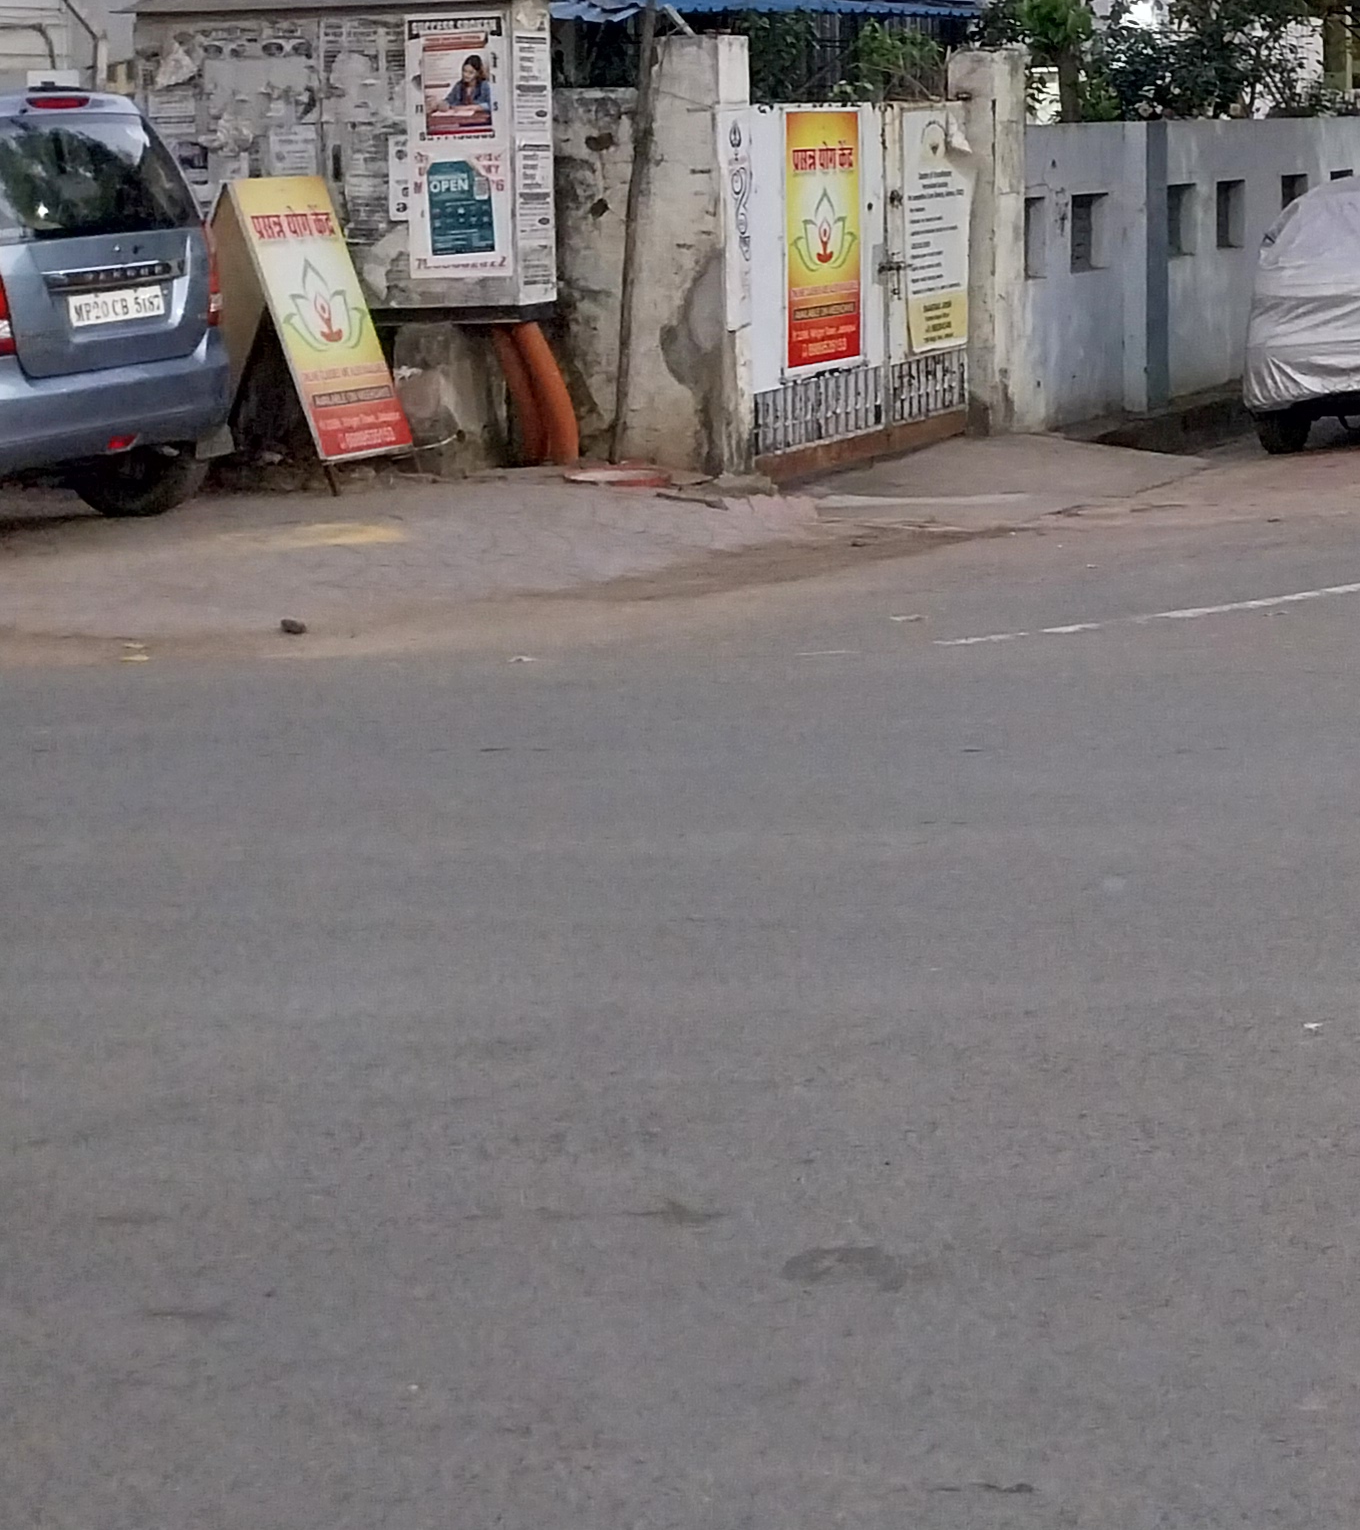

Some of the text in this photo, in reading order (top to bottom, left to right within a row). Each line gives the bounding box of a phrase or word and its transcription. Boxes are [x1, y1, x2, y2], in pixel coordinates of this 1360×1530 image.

[818, 140, 836, 170] योग
[430, 180, 469, 193] OPEN
[284, 205, 313, 237] योग
[74, 299, 109, 323] MP20
[112, 298, 130, 317] CB
